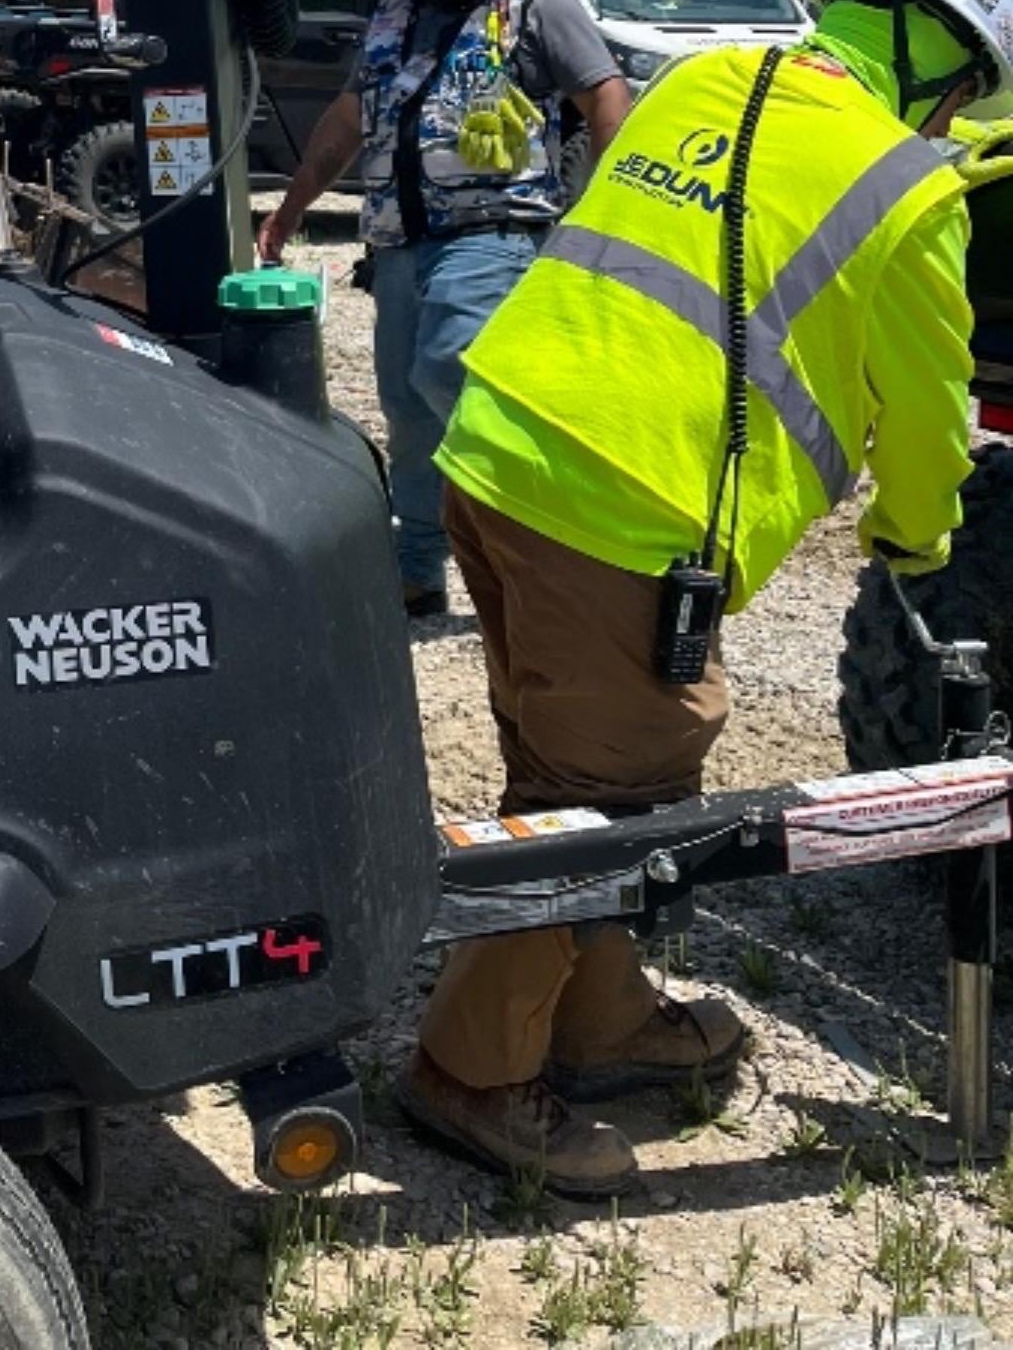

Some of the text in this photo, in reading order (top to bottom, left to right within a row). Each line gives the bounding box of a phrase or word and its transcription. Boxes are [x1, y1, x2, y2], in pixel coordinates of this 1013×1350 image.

[8, 601, 208, 649] WACKER
[14, 635, 211, 686] NEUSON
[99, 927, 323, 1008] LTT4
